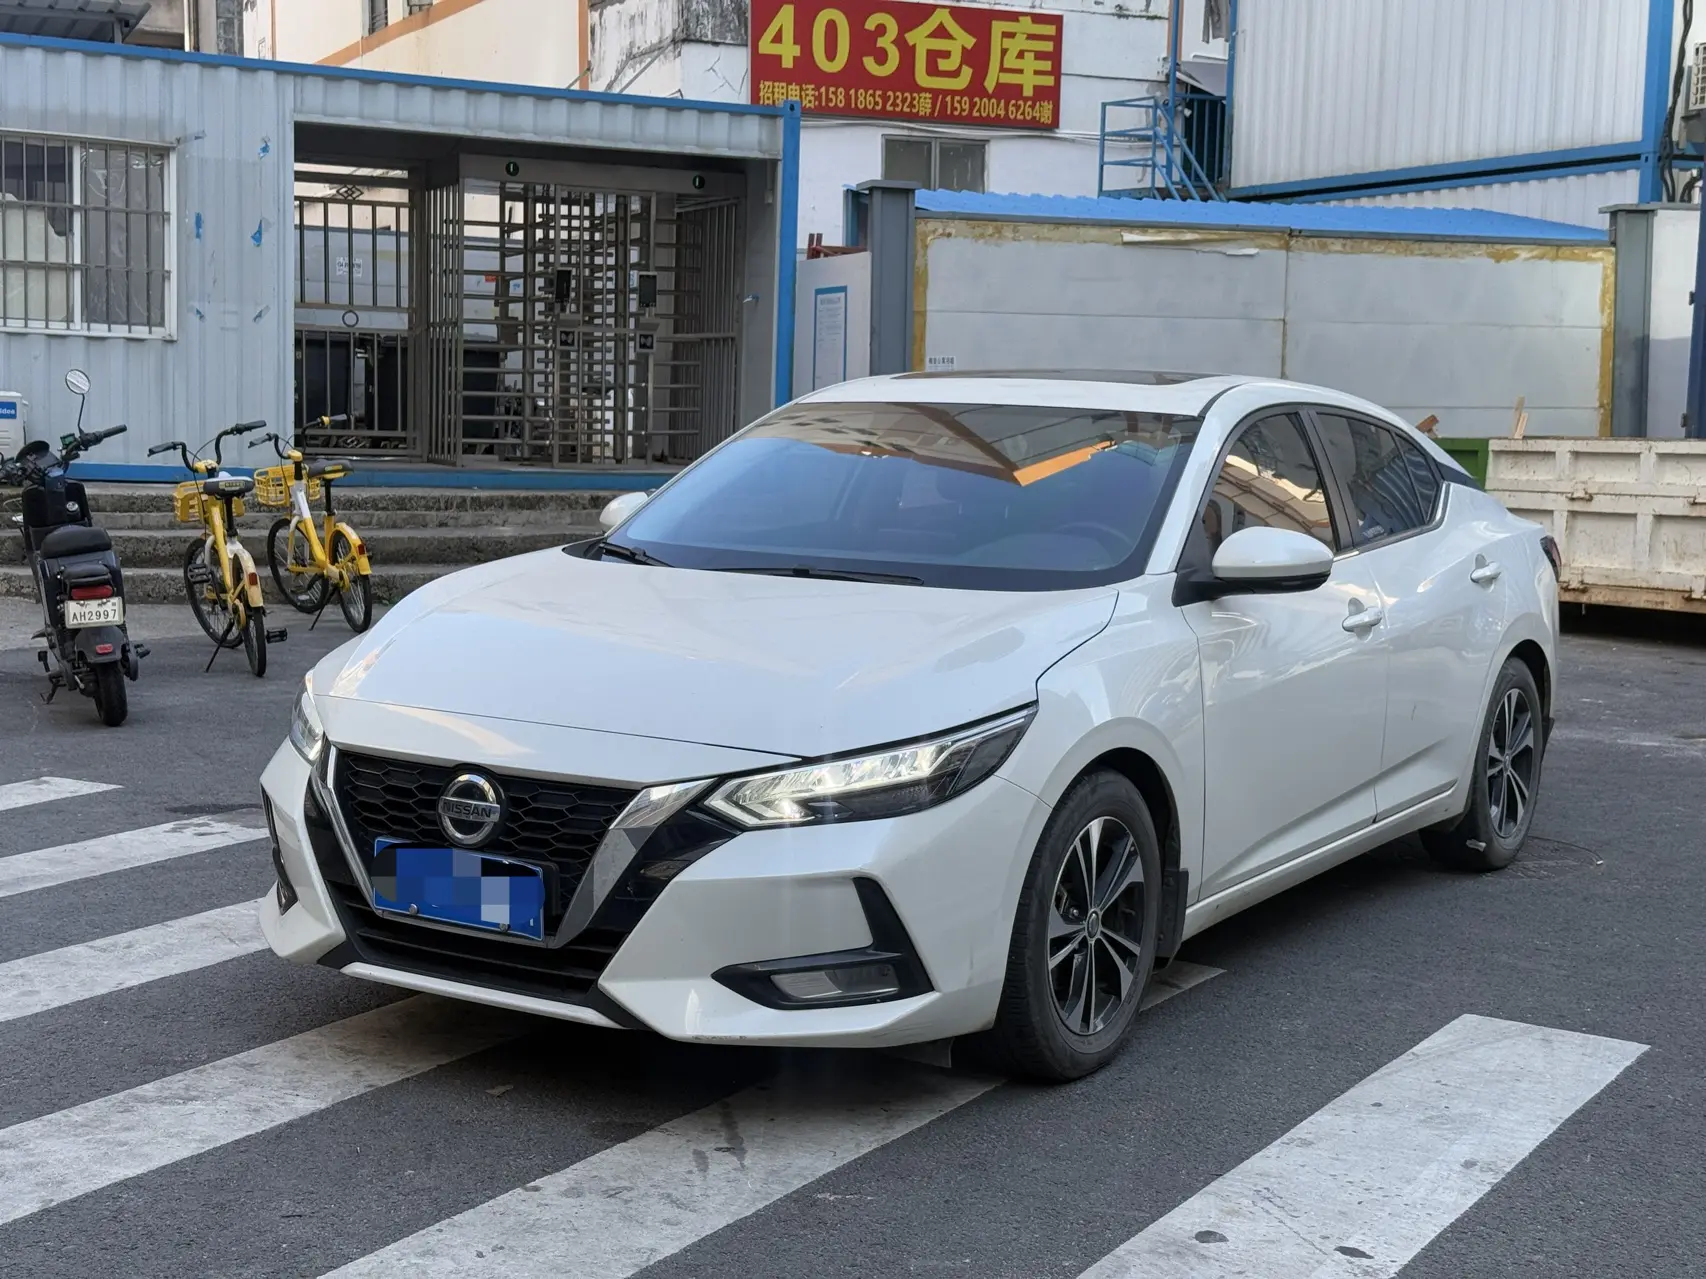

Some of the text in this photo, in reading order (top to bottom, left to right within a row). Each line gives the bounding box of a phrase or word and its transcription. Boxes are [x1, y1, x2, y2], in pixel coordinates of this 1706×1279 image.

[758, 4, 1056, 97] 403仓库
[849, 88, 882, 110] 1865
[945, 94, 969, 116] 159
[972, 97, 1005, 119] 2004
[71, 608, 117, 622] AH2997
[442, 801, 492, 818] NISSAN
